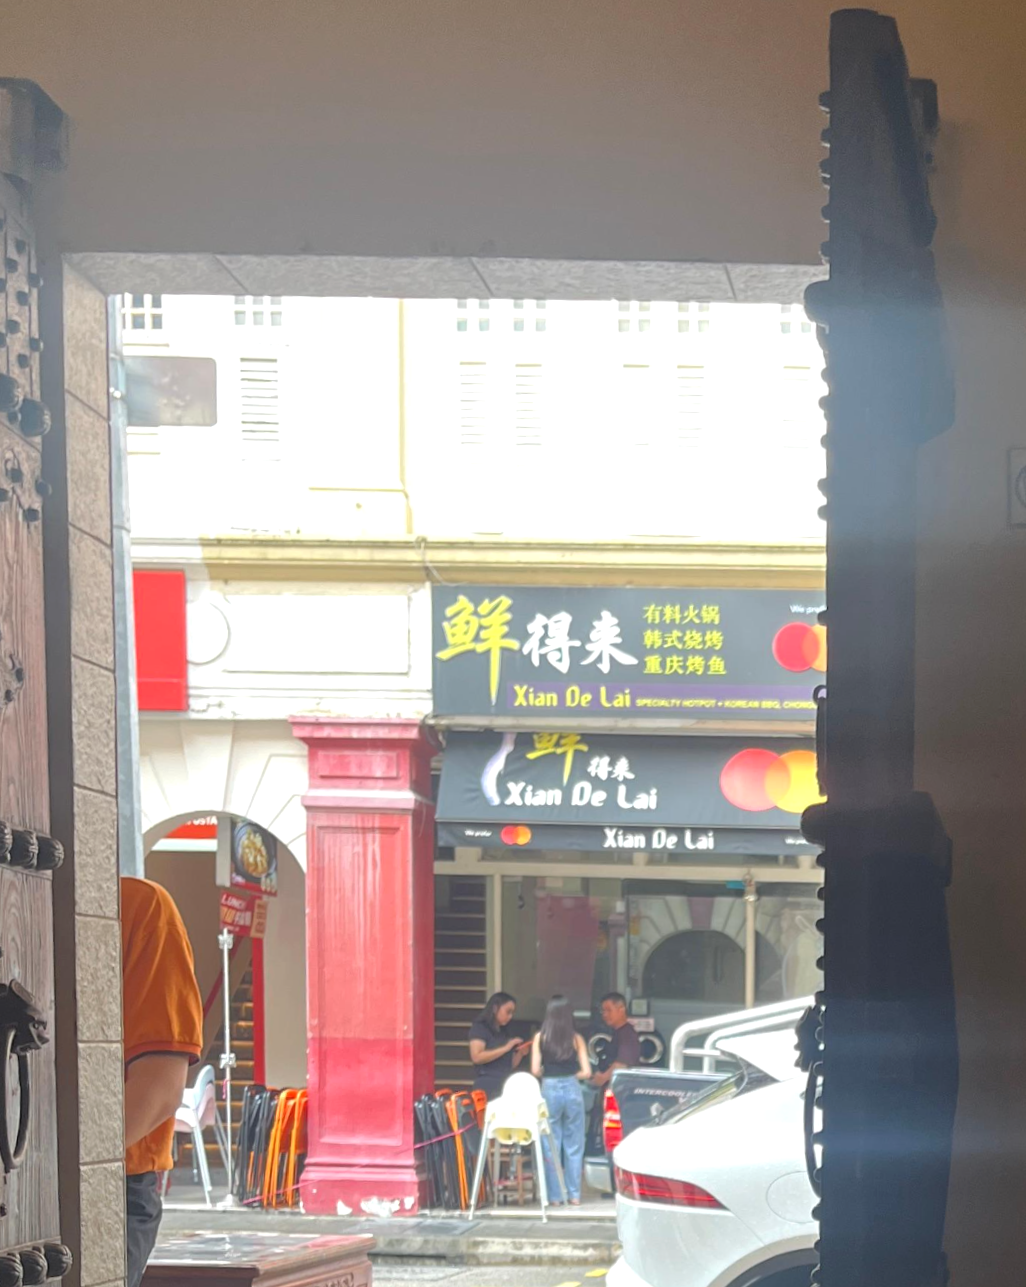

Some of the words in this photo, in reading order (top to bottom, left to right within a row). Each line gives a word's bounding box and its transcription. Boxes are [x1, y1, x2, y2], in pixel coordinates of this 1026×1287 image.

[642, 603, 721, 625] 有料火锅
[642, 629, 724, 650] 韩式烧烤
[642, 654, 727, 675] 重庆烤鱼
[513, 684, 558, 707] Xian
[565, 684, 592, 707] De
[600, 685, 631, 707] Lai
[635, 698, 680, 708] SPECIALTY
[504, 781, 562, 806] Xian
[571, 780, 607, 807] De
[617, 783, 658, 810] Lai
[603, 827, 646, 848] Xian
[652, 828, 678, 849] De
[684, 828, 715, 850] Lai
